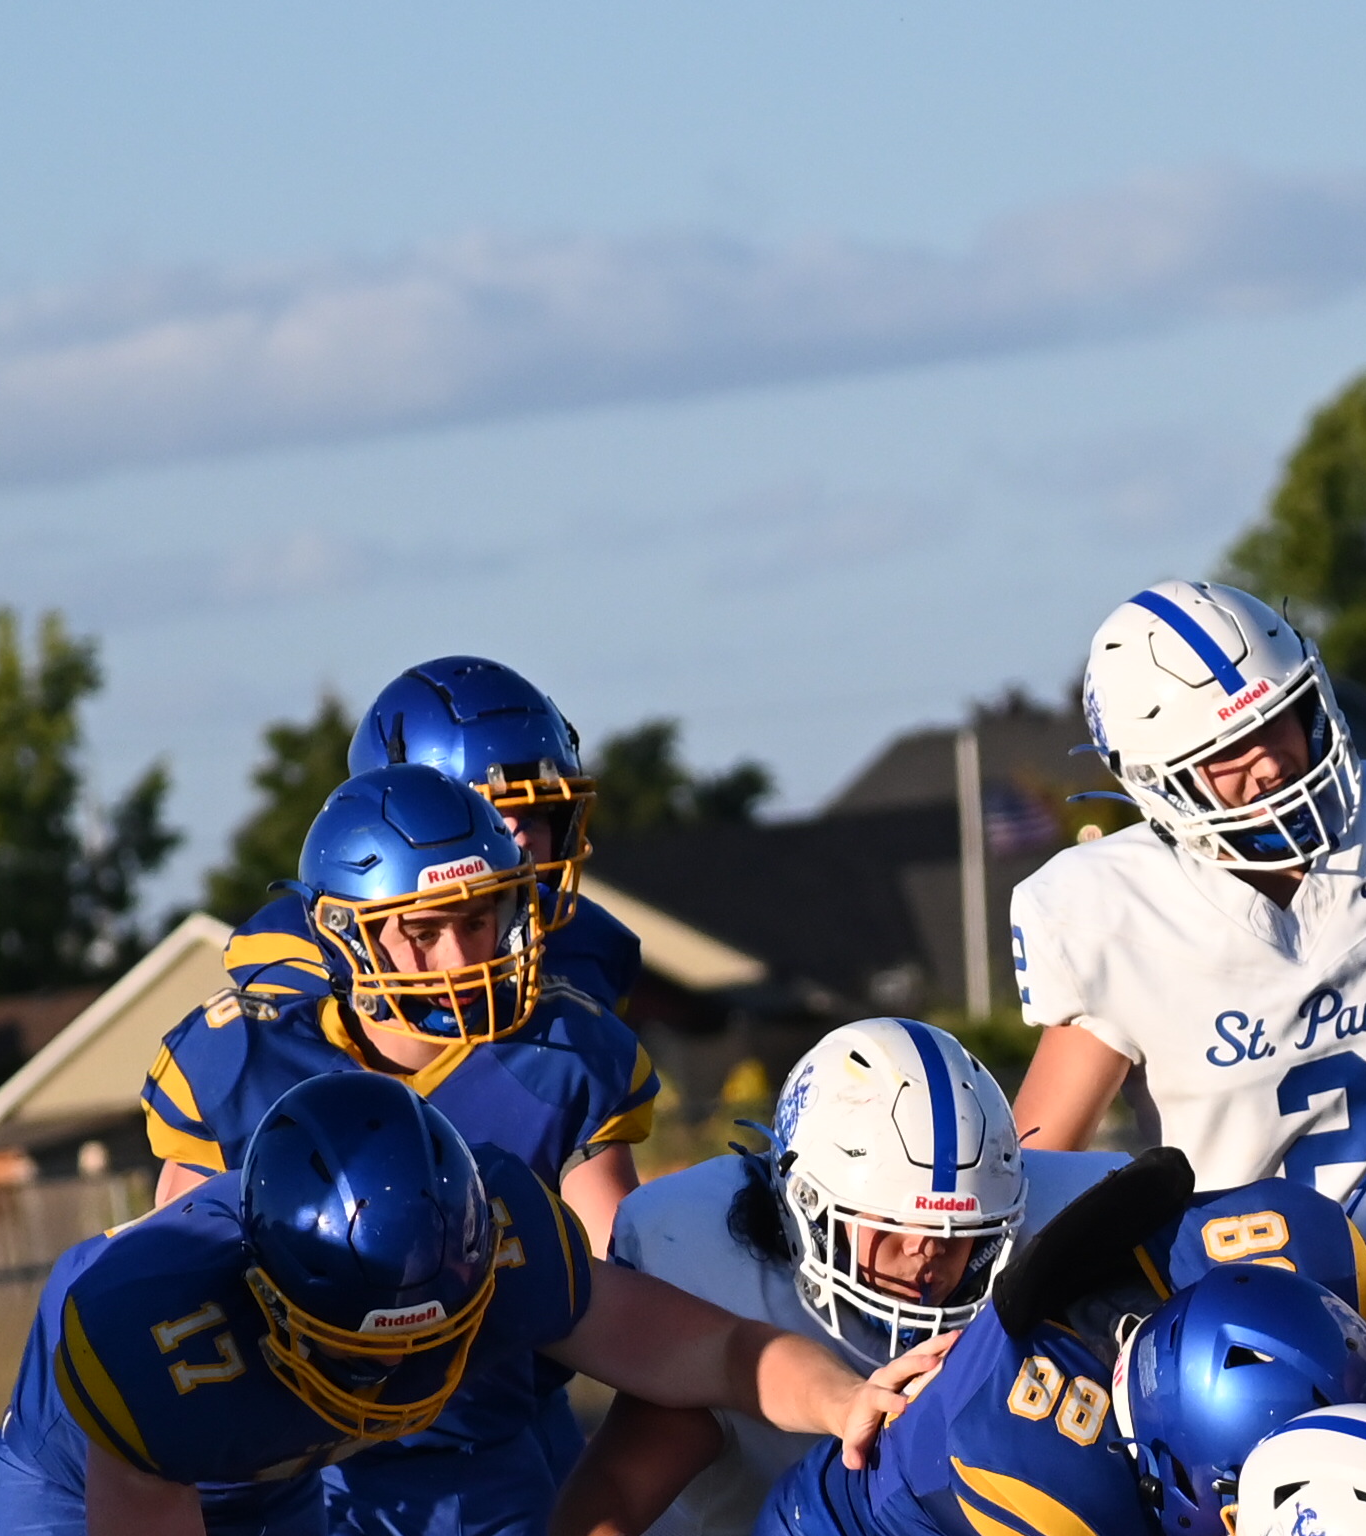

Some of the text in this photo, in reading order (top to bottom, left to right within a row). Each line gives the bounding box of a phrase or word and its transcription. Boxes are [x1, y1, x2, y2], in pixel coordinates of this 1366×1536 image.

[1217, 680, 1270, 721] Riddell
[427, 859, 485, 884] Riddell
[1206, 1010, 1277, 1068] St.
[915, 1196, 975, 1211] Riddell
[968, 1231, 1007, 1274] Ridde
[374, 1307, 437, 1328] Riddell
[150, 1300, 247, 1396] 17
[1007, 1355, 1110, 1447] 88
